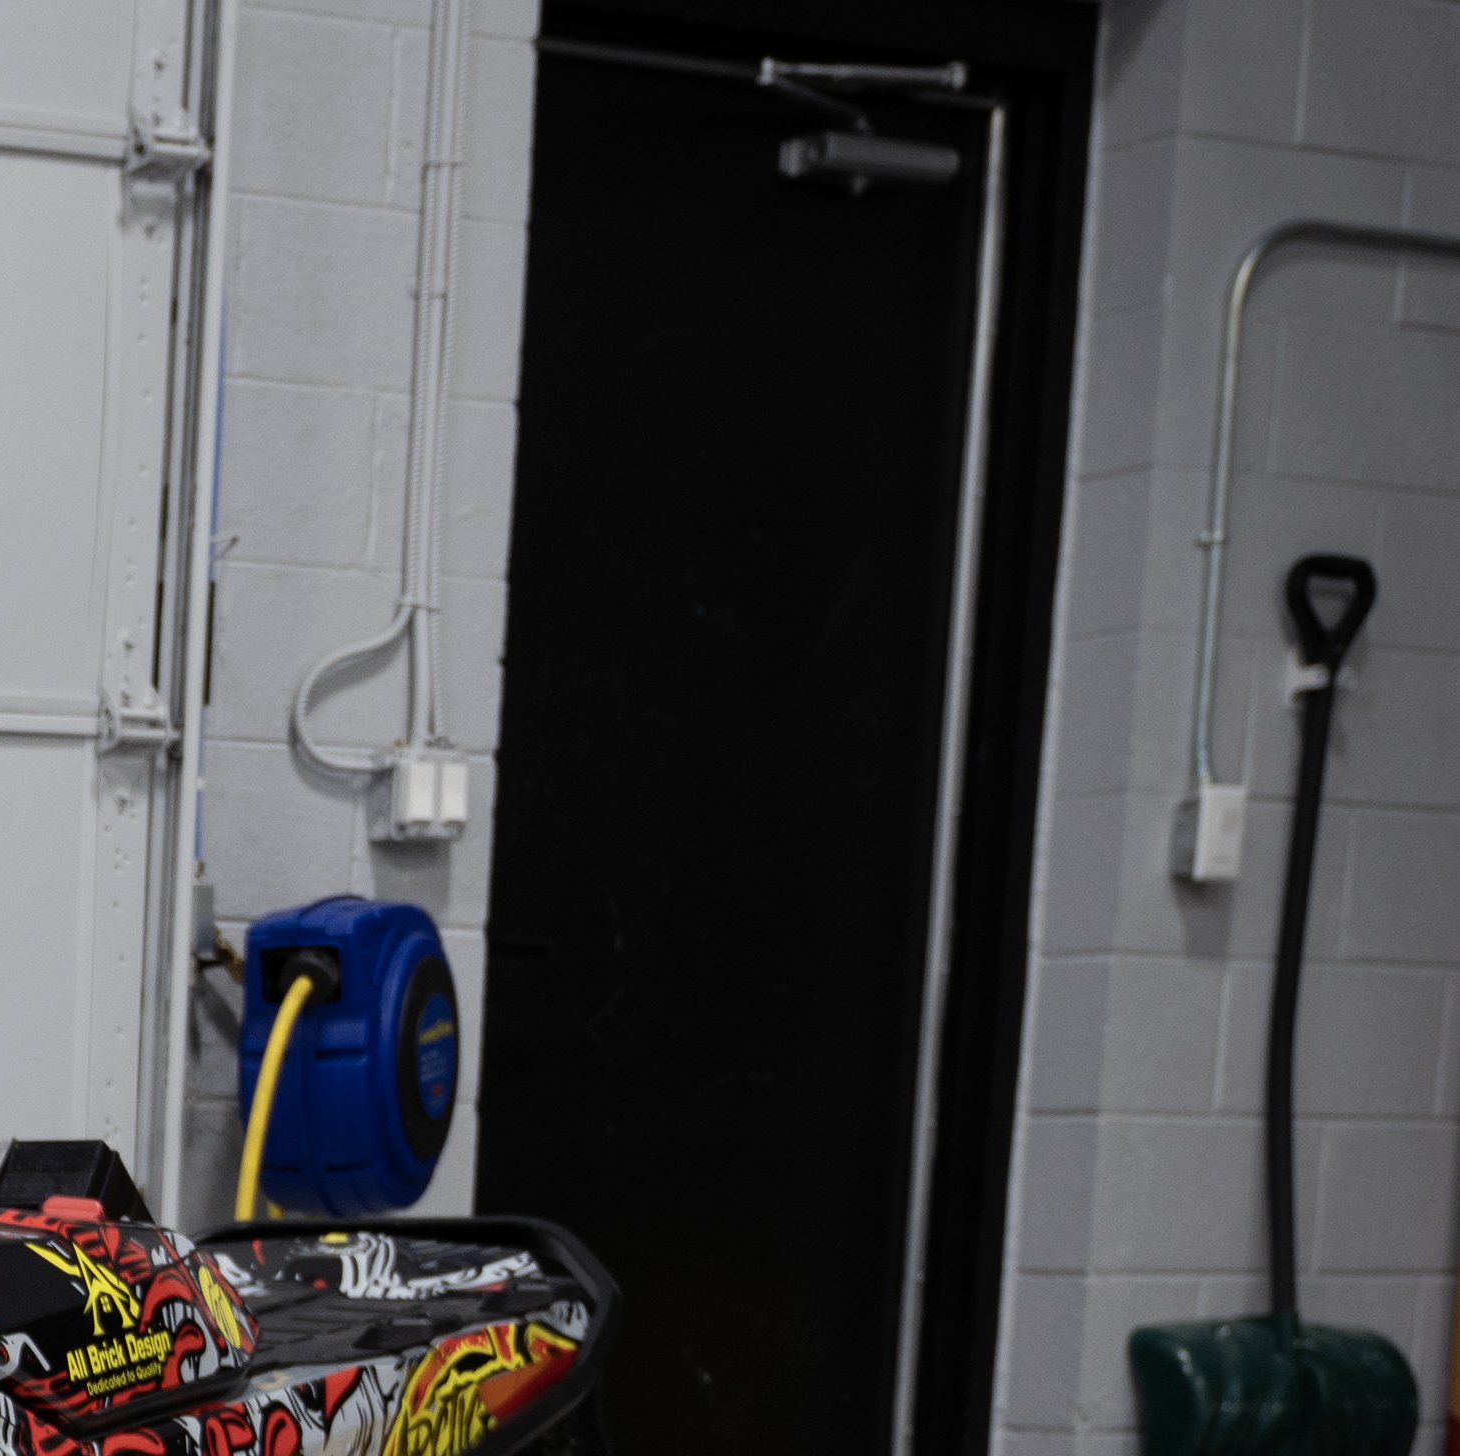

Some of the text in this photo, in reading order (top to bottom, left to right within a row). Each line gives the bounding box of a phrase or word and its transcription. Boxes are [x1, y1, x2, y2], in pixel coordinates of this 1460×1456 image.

[66, 1327, 173, 1382] All Brick Design
[86, 1371, 128, 1397] Dedicated
